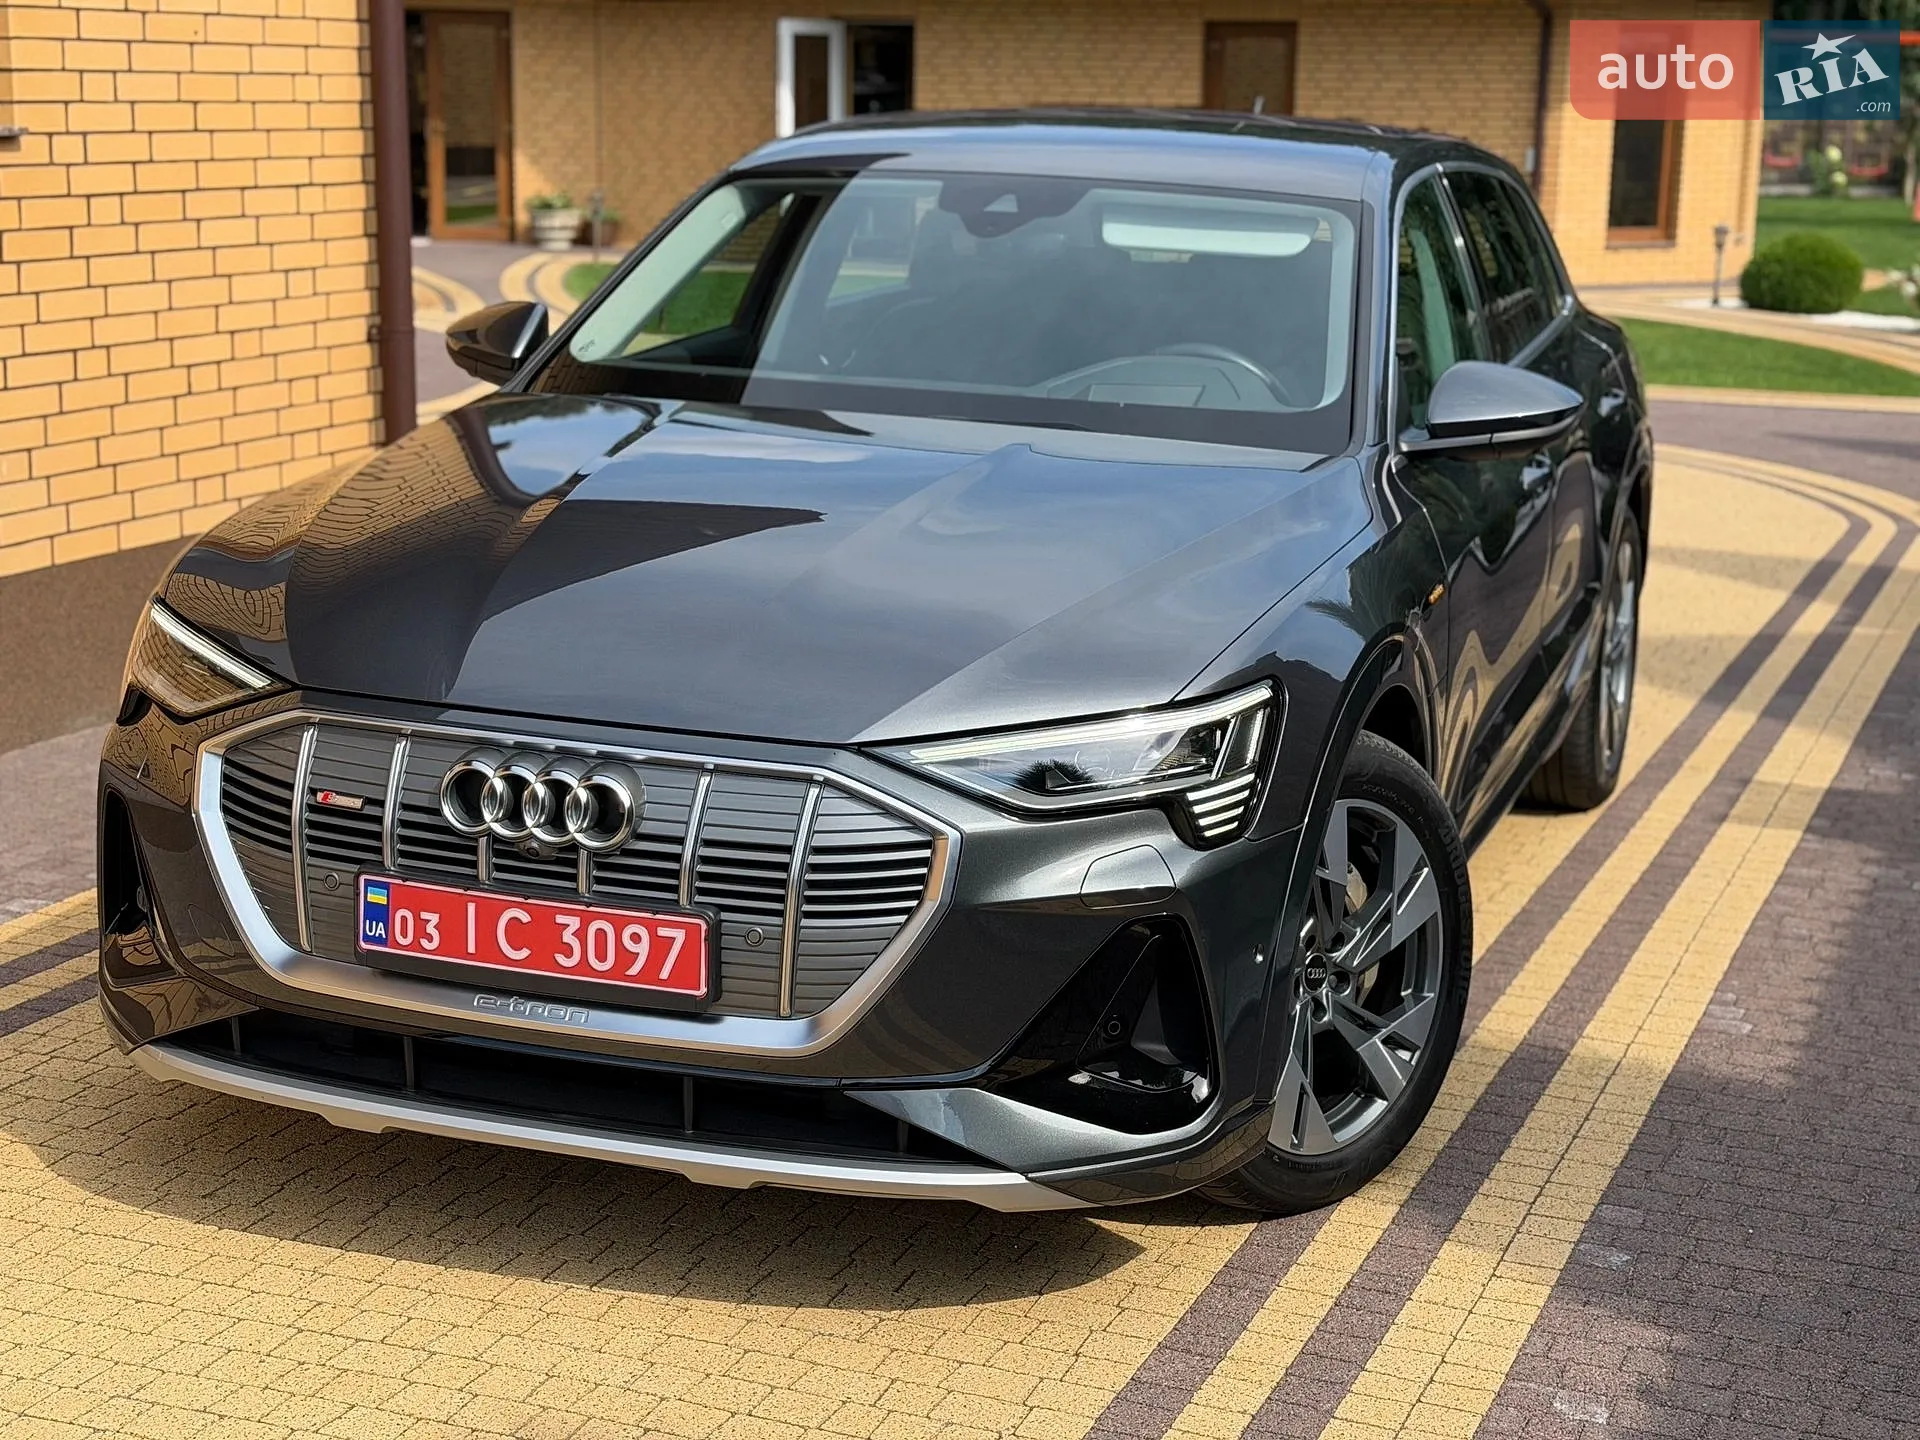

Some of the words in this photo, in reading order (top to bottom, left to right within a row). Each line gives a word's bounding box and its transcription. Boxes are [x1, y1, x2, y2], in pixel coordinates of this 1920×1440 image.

[365, 920, 386, 939] UA
[394, 908, 441, 951] 03
[554, 914, 687, 980] 3097
[473, 993, 590, 1023] e-tron
